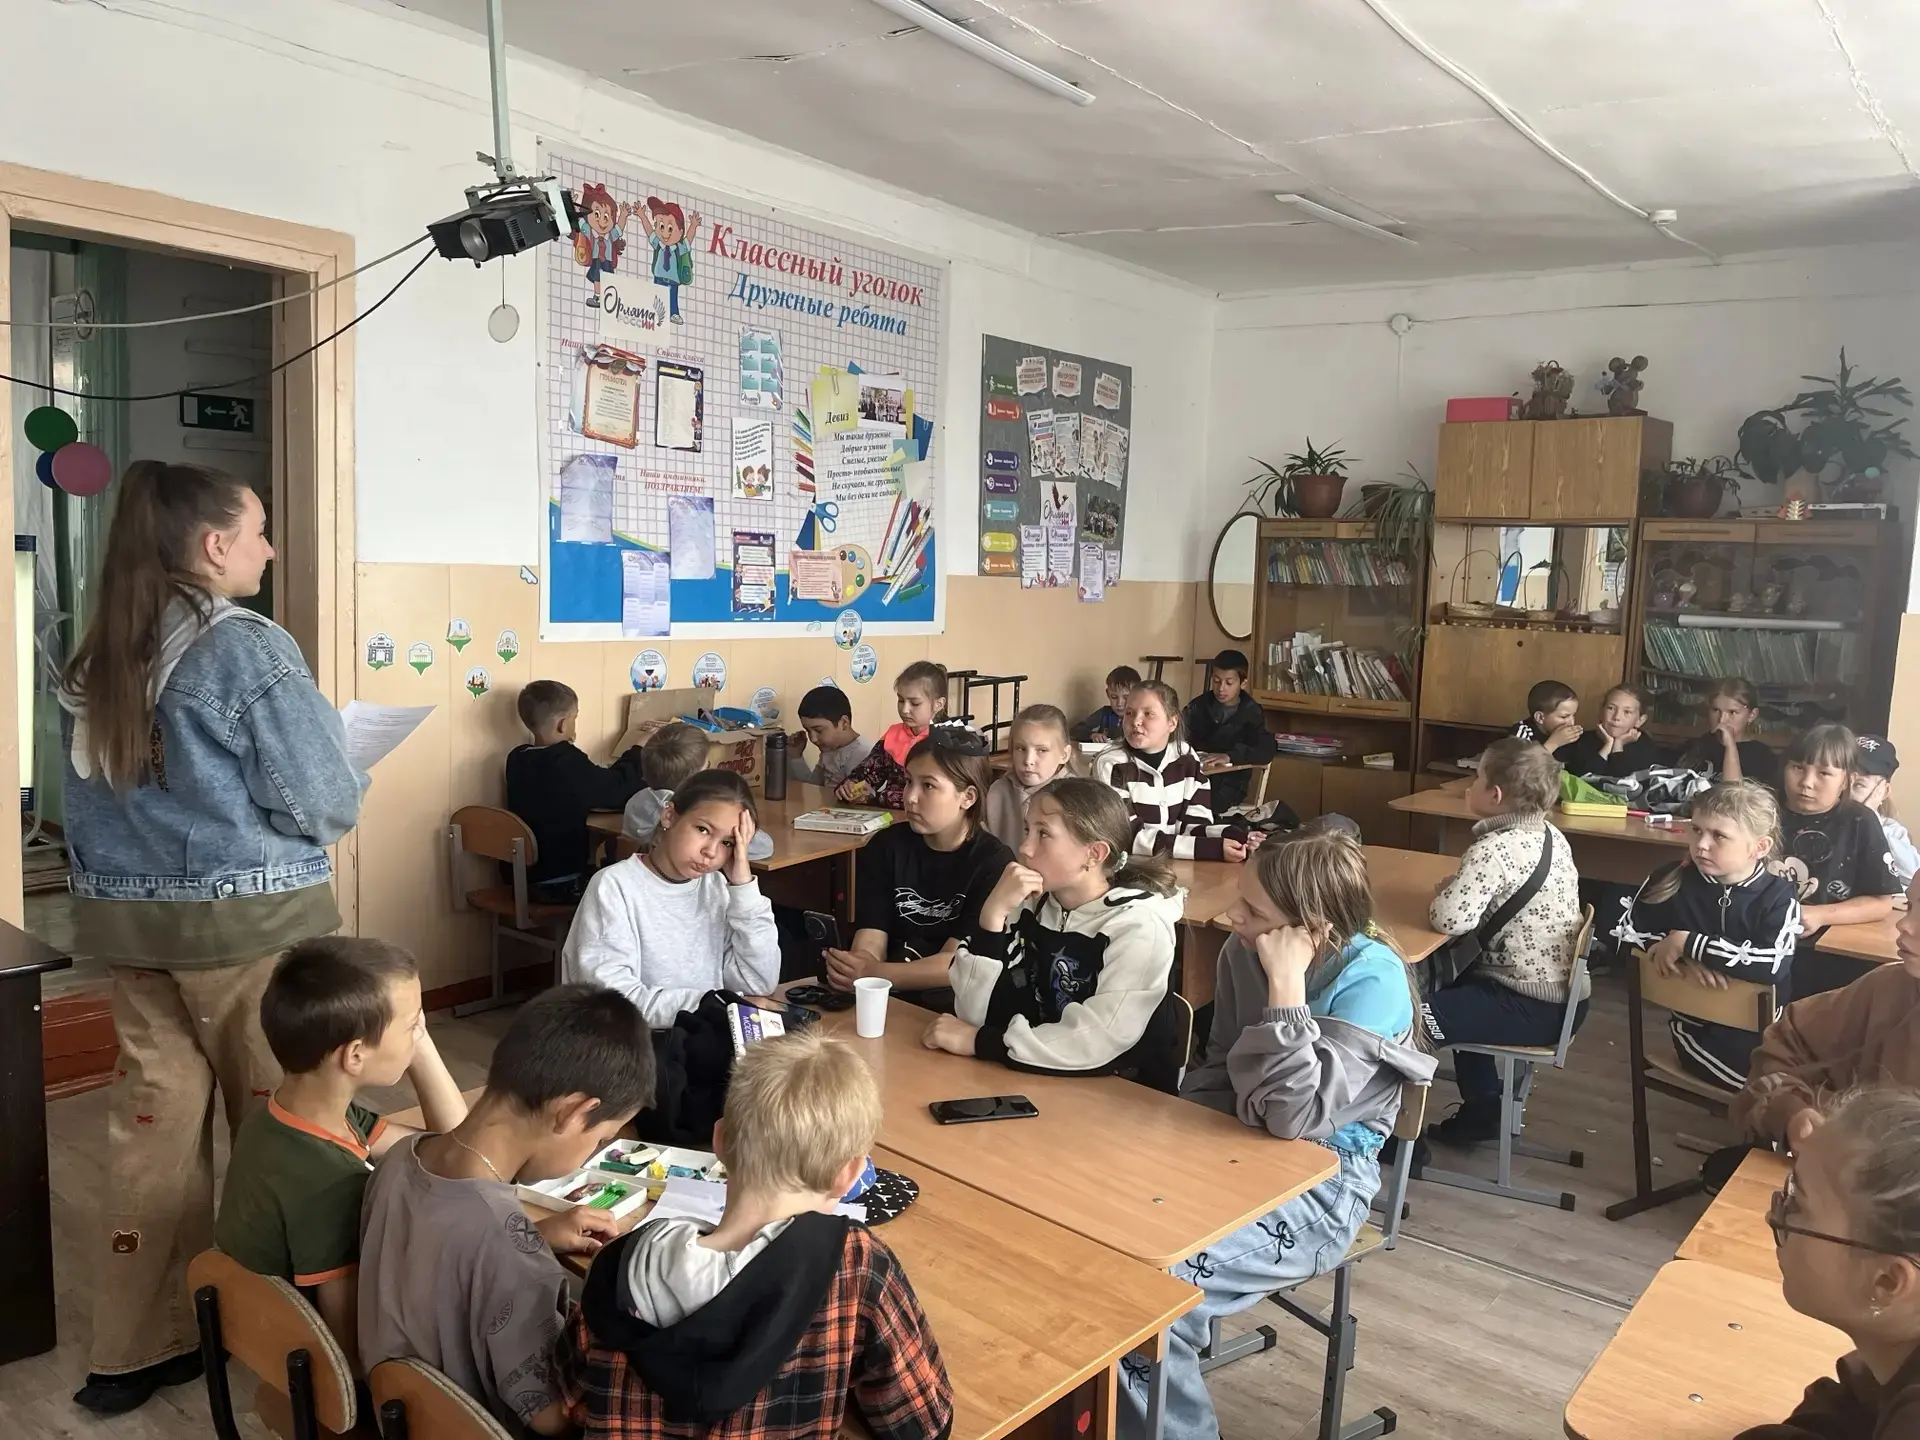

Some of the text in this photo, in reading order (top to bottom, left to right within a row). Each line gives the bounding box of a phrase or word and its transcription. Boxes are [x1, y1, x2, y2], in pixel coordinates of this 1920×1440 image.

[708, 222, 925, 307] Классный уголок
[604, 285, 656, 321] Орлята
[728, 271, 908, 336] Дружные ребята
[825, 411, 849, 424] Девиз
[834, 432, 845, 441] Мы
